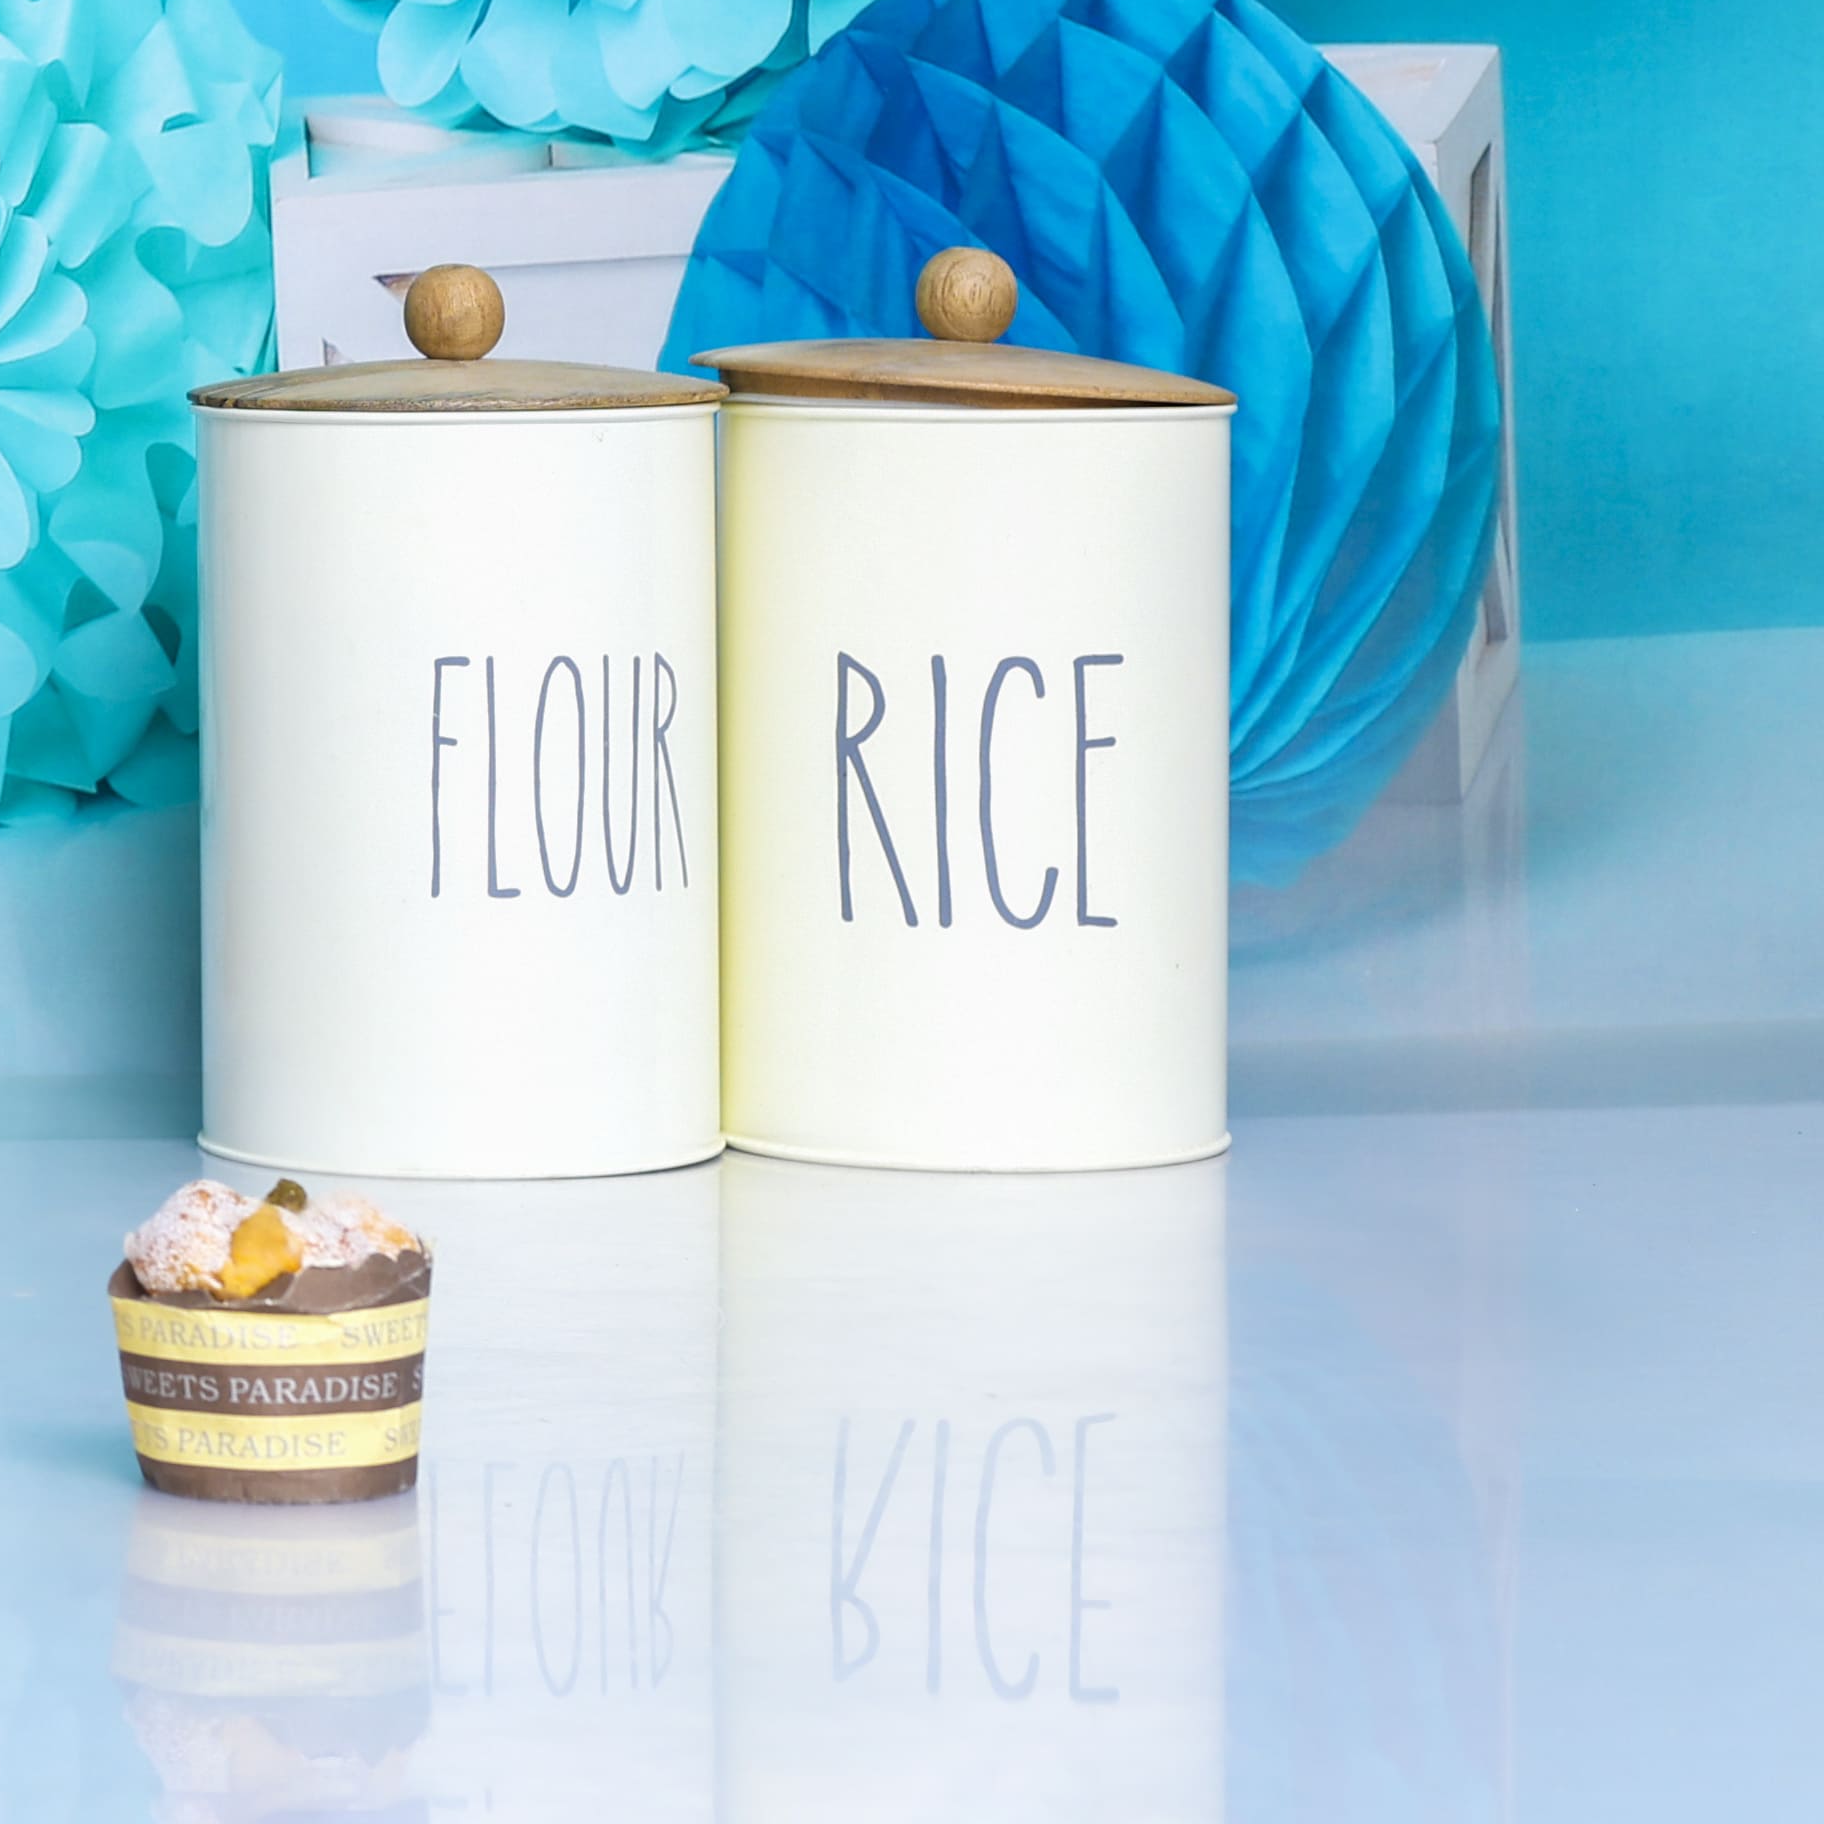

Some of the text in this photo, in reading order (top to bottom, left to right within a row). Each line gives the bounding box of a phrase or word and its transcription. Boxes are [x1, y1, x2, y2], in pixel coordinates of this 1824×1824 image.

[431, 654, 688, 898] FLOUR
[834, 650, 1125, 930] RICE
[139, 1315, 298, 1350] PARADISE
[228, 1370, 400, 1406] PARADISE
[177, 1426, 348, 1461] PARADISE
